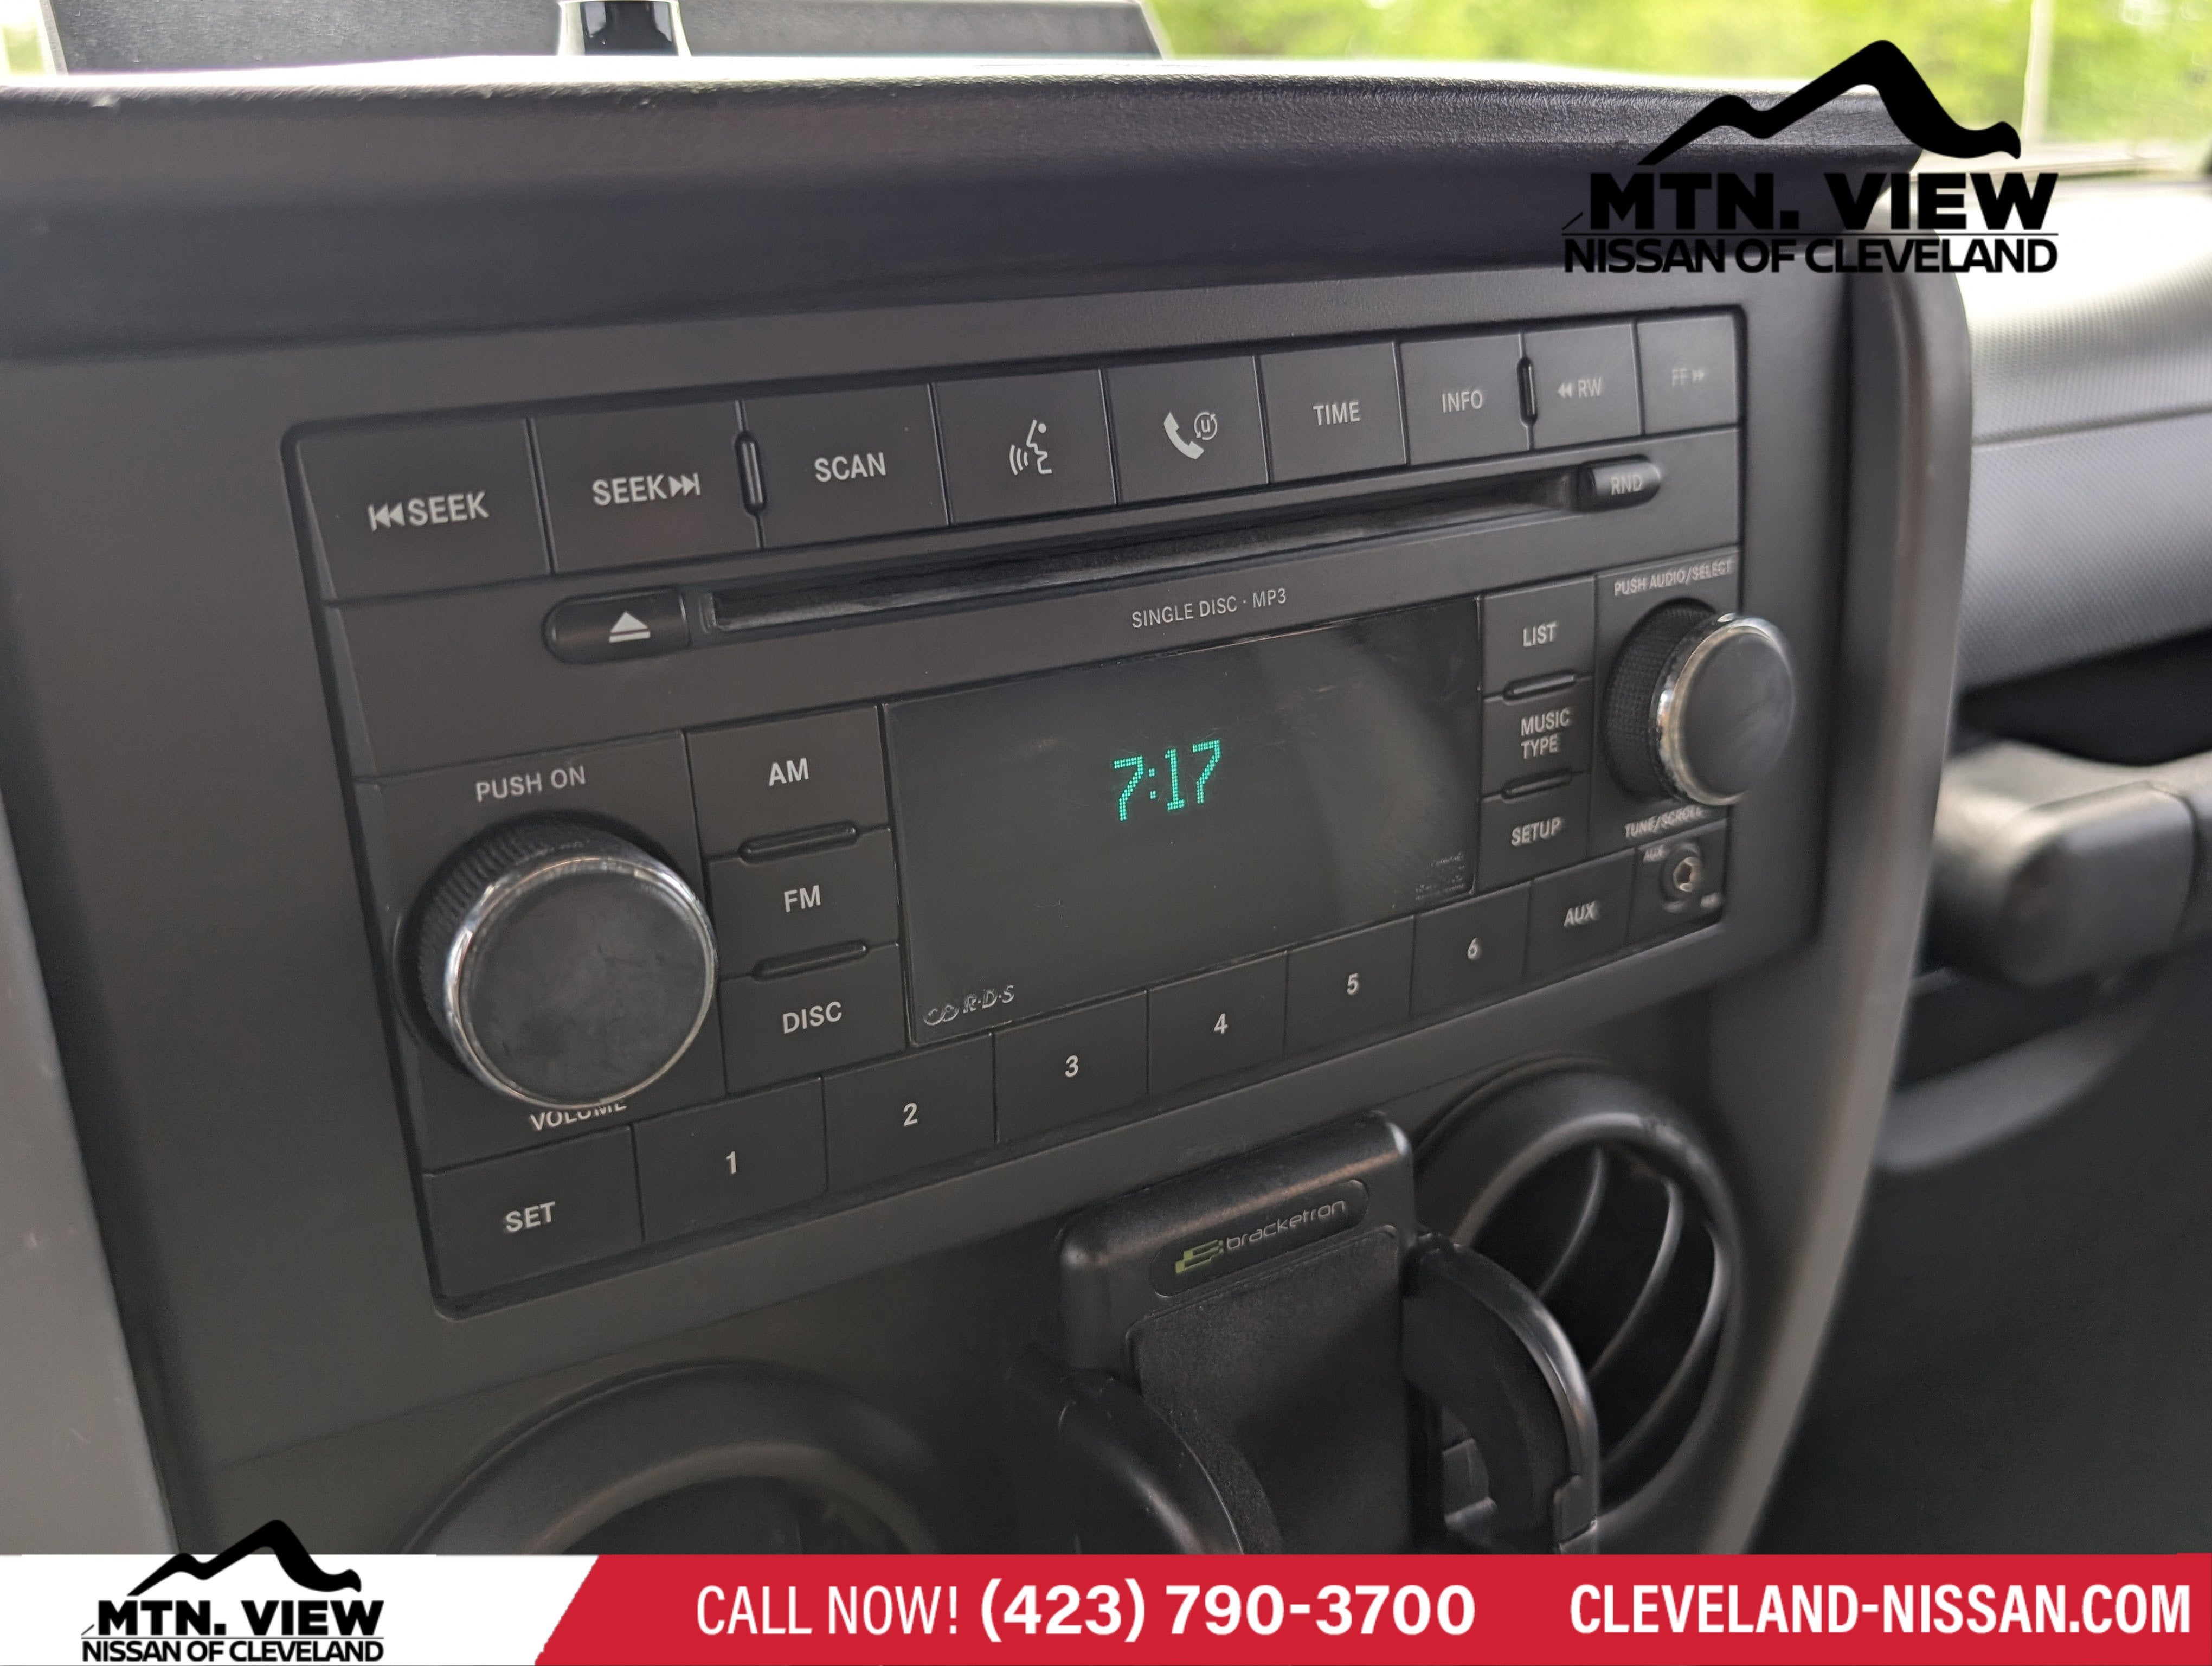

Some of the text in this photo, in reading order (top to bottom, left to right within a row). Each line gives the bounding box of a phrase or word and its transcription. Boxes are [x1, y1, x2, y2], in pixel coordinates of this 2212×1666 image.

[1442, 390, 1483, 413] INFO
[1578, 378, 1602, 399] RW
[1313, 401, 1360, 426] TIME
[814, 452, 886, 483] SCAN
[592, 473, 667, 505] SEEK
[1610, 473, 1643, 495] RND
[408, 491, 489, 526] SEEK
[1613, 577, 1647, 596] PUSH
[1131, 588, 1287, 629] SINGLE DISC MP3
[1522, 621, 1558, 647] LIST
[1520, 707, 1570, 736] MUSIC
[1520, 734, 1560, 759] TYPE
[475, 766, 586, 802] PUSH ON
[768, 758, 809, 786] AM
[1114, 740, 1220, 821] 7:17
[1511, 816, 1564, 847] SETUP
[783, 885, 821, 912] FM
[1564, 900, 1598, 927] AUX
[1468, 938, 1481, 960] 6
[1347, 973, 1359, 996] 5
[782, 1001, 843, 1034] DISC
[1213, 1013, 1228, 1034] 4
[1064, 1055, 1079, 1078] 3
[903, 1103, 918, 1127] 2
[725, 1151, 737, 1174] 1
[505, 1202, 556, 1232] SET
[1226, 1200, 1346, 1251] bracketron
